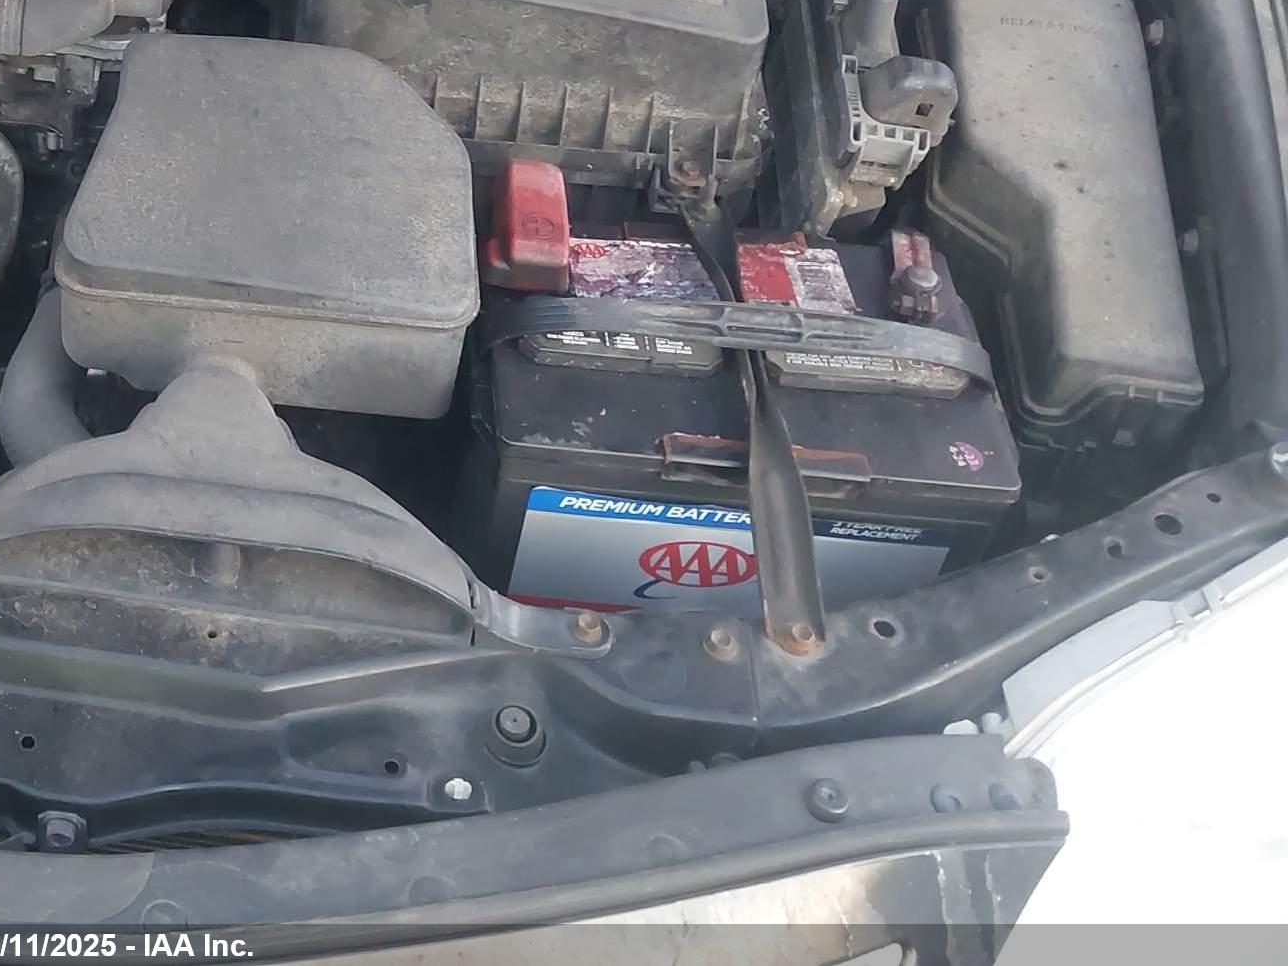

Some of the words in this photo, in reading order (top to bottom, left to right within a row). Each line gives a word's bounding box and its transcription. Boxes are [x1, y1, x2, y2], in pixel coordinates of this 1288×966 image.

[560, 496, 665, 517] PREMIUM
[666, 506, 752, 525] BATTER
[830, 527, 919, 541] REPLACEMENT
[642, 542, 757, 587] AAA
